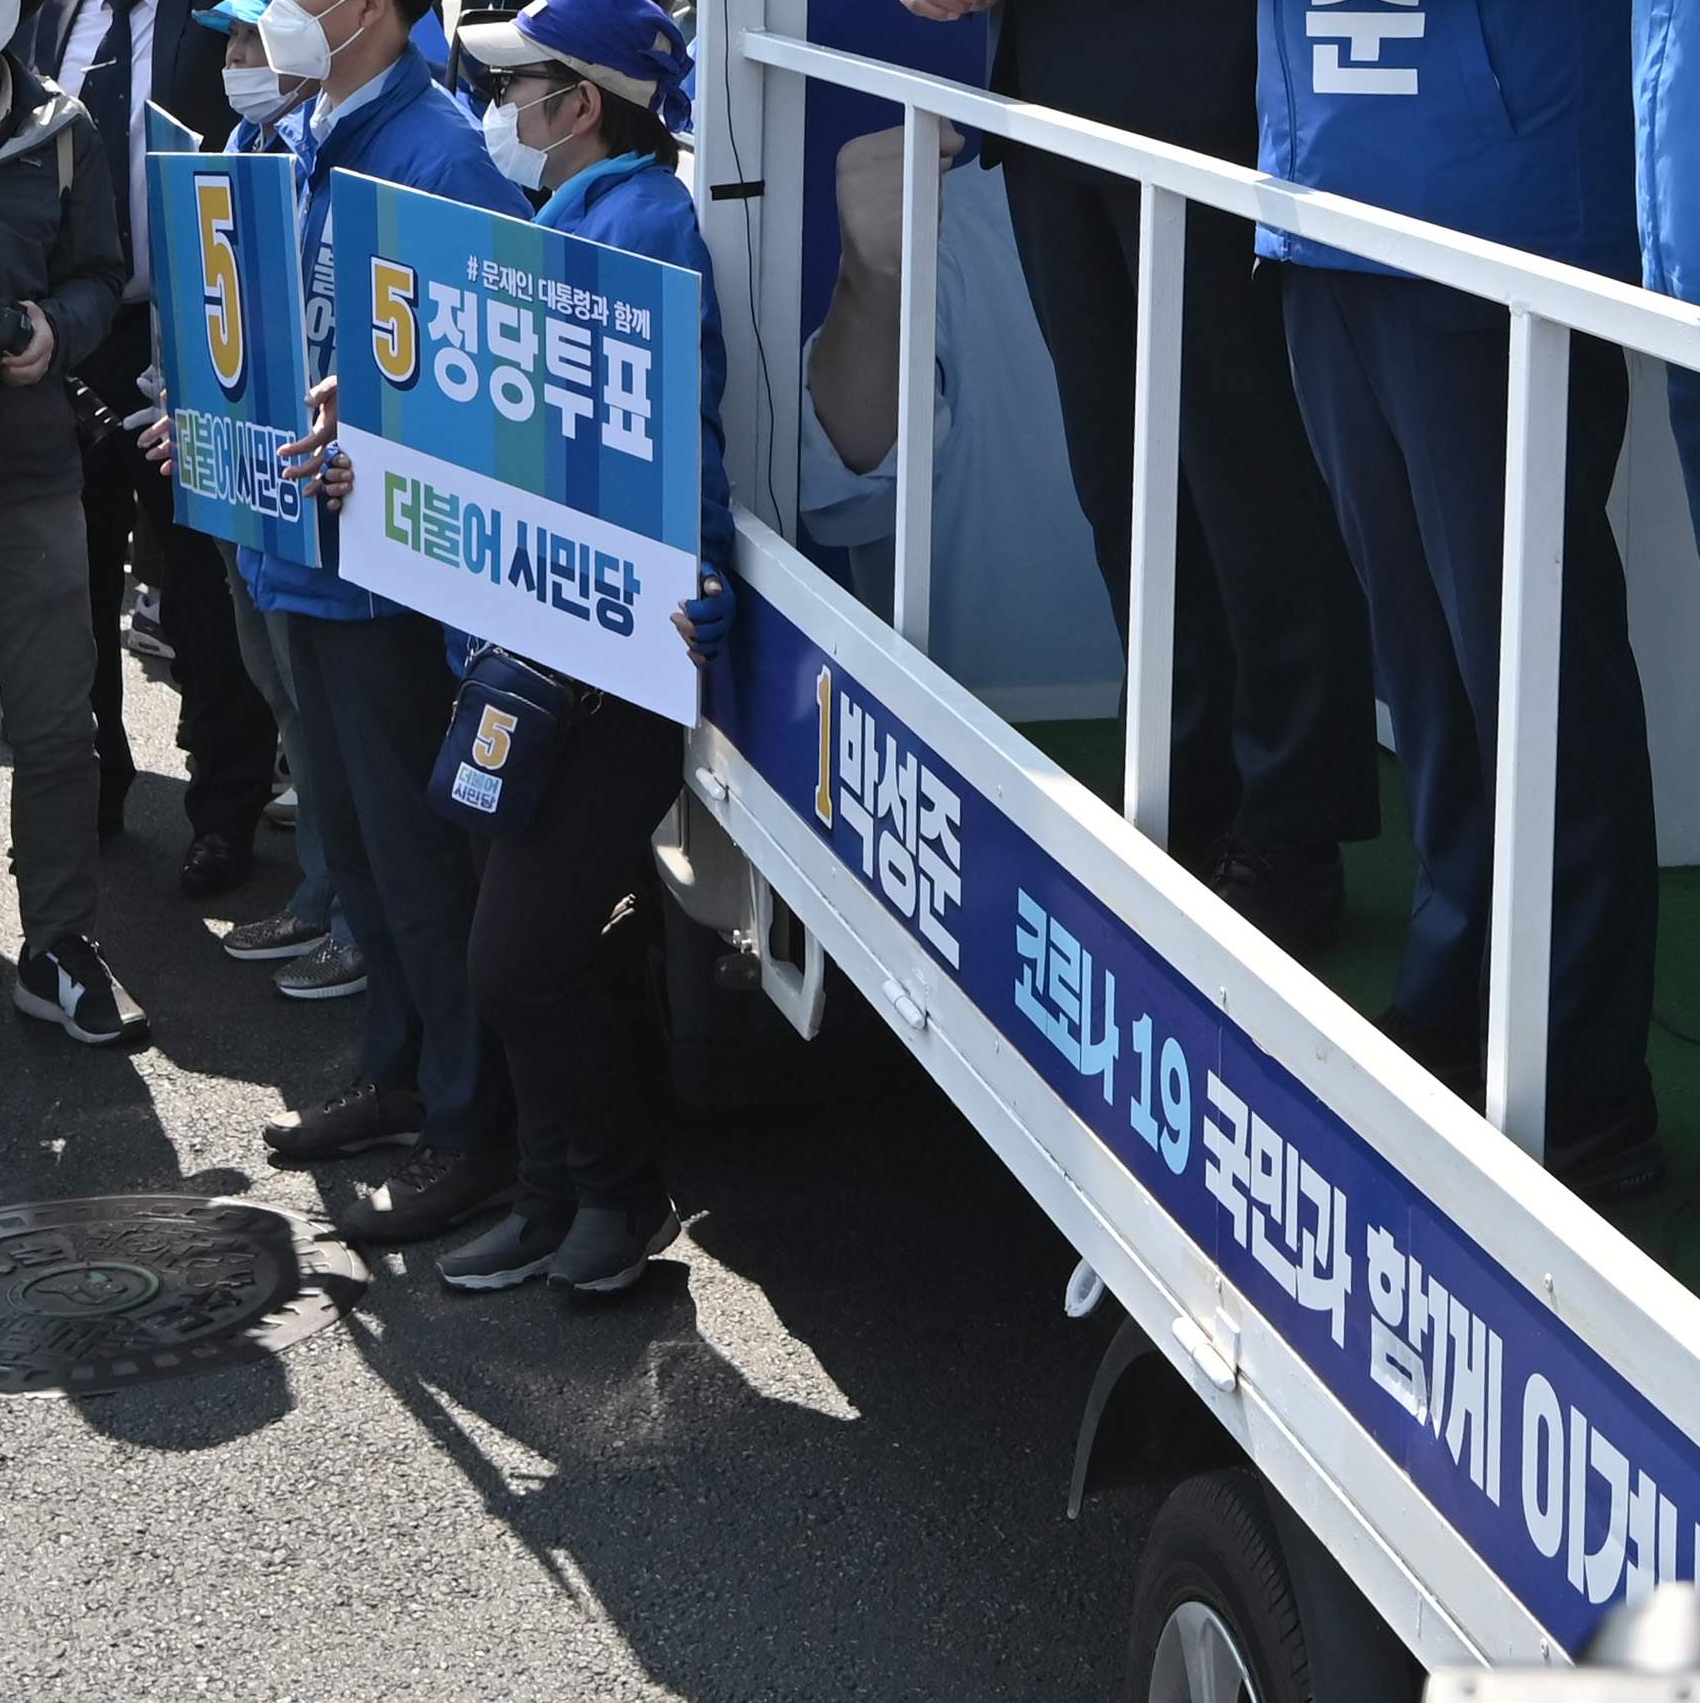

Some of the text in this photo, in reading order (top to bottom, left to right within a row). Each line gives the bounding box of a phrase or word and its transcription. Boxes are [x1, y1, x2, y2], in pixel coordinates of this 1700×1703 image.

[194, 174, 243, 390] 5
[370, 256, 415, 383] 5
[427, 280, 653, 462] 정당투표
[481, 259, 534, 302] 문재인
[538, 277, 610, 327] 대통령과
[614, 300, 651, 341] 함께
[174, 408, 300, 523] 더불어 시민당
[384, 470, 642, 638] 더불어 시민당
[472, 703, 519, 771] 5
[814, 663, 834, 829] 1
[838, 691, 962, 971] 박성준
[1013, 886, 1120, 1106] 코로나
[1130, 1011, 1193, 1174] 19
[1203, 1069, 1352, 1349] 국민과
[1366, 1223, 1504, 1508] 함께
